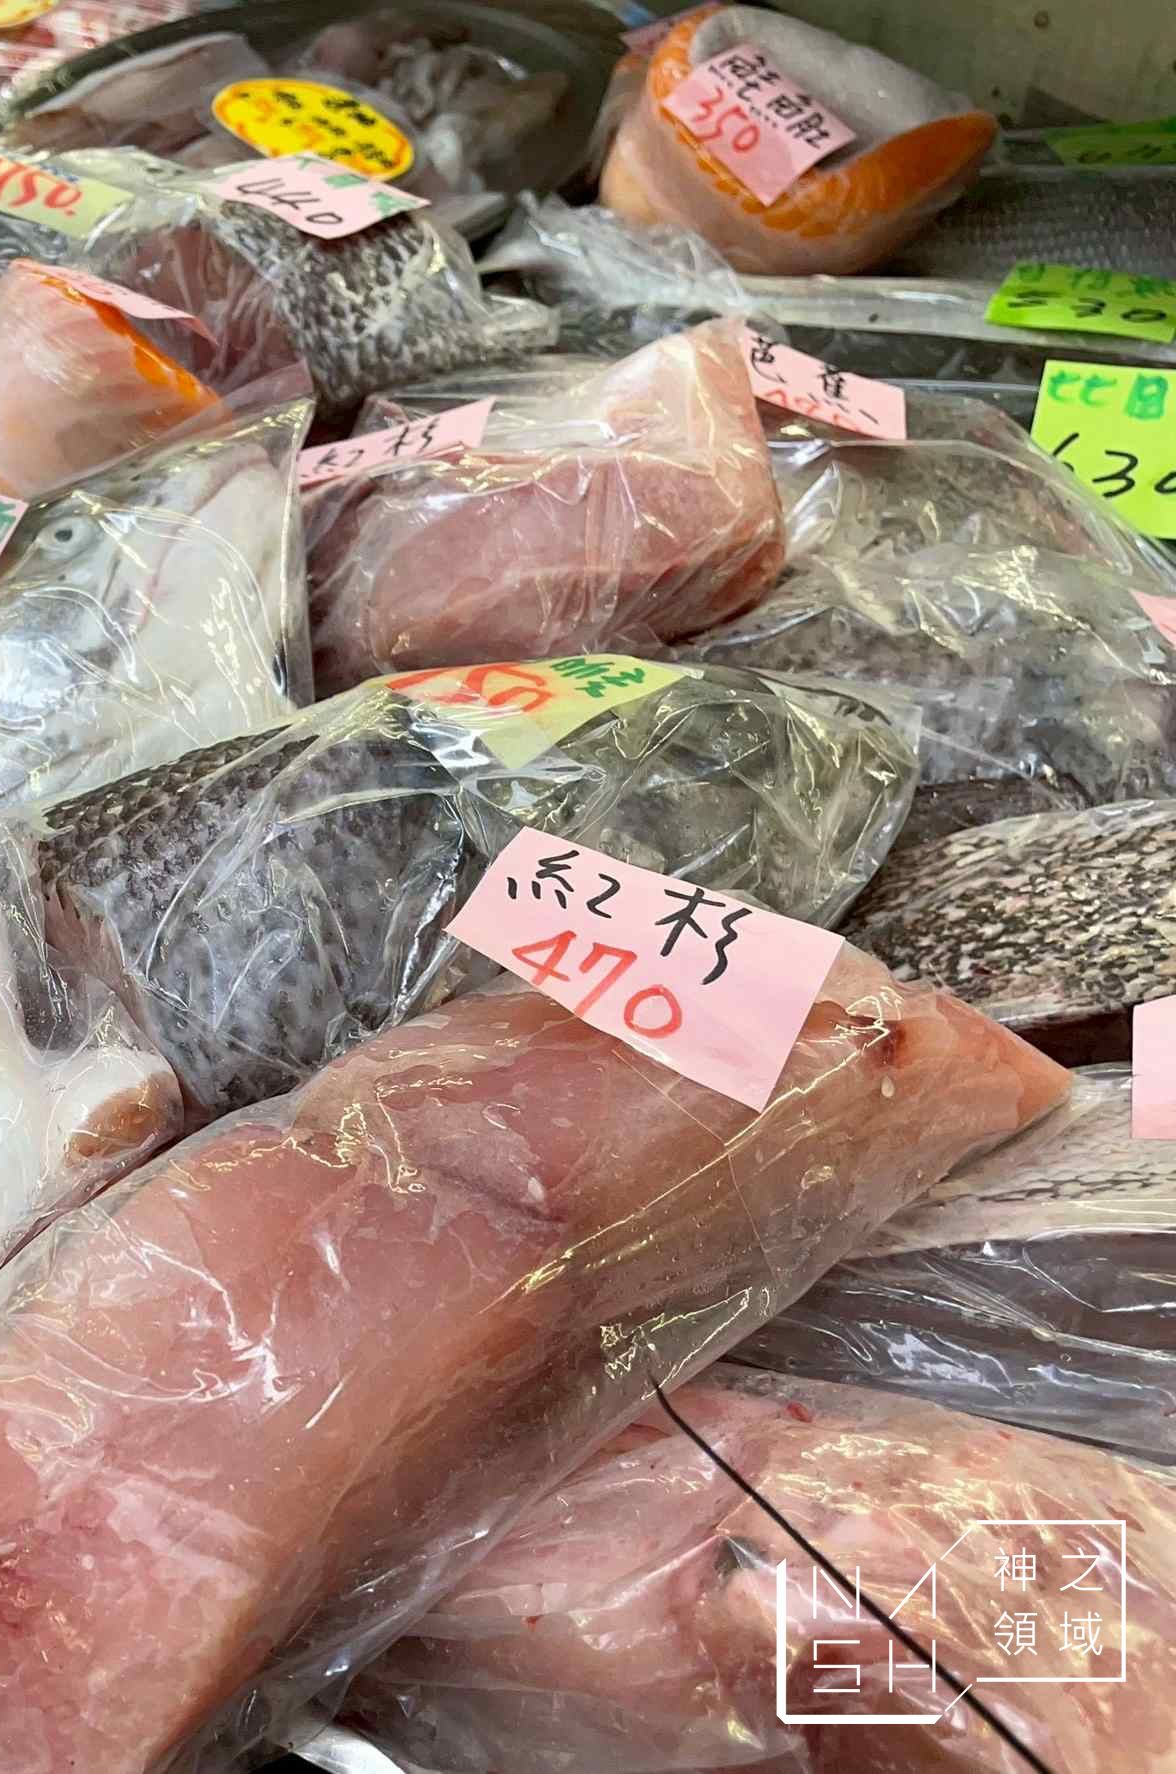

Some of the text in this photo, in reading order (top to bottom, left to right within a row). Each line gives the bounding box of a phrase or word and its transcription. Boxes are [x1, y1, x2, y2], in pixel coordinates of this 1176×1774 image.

[691, 87, 761, 153] 350
[506, 848, 754, 987] 紅杉
[510, 929, 684, 1039] 470
